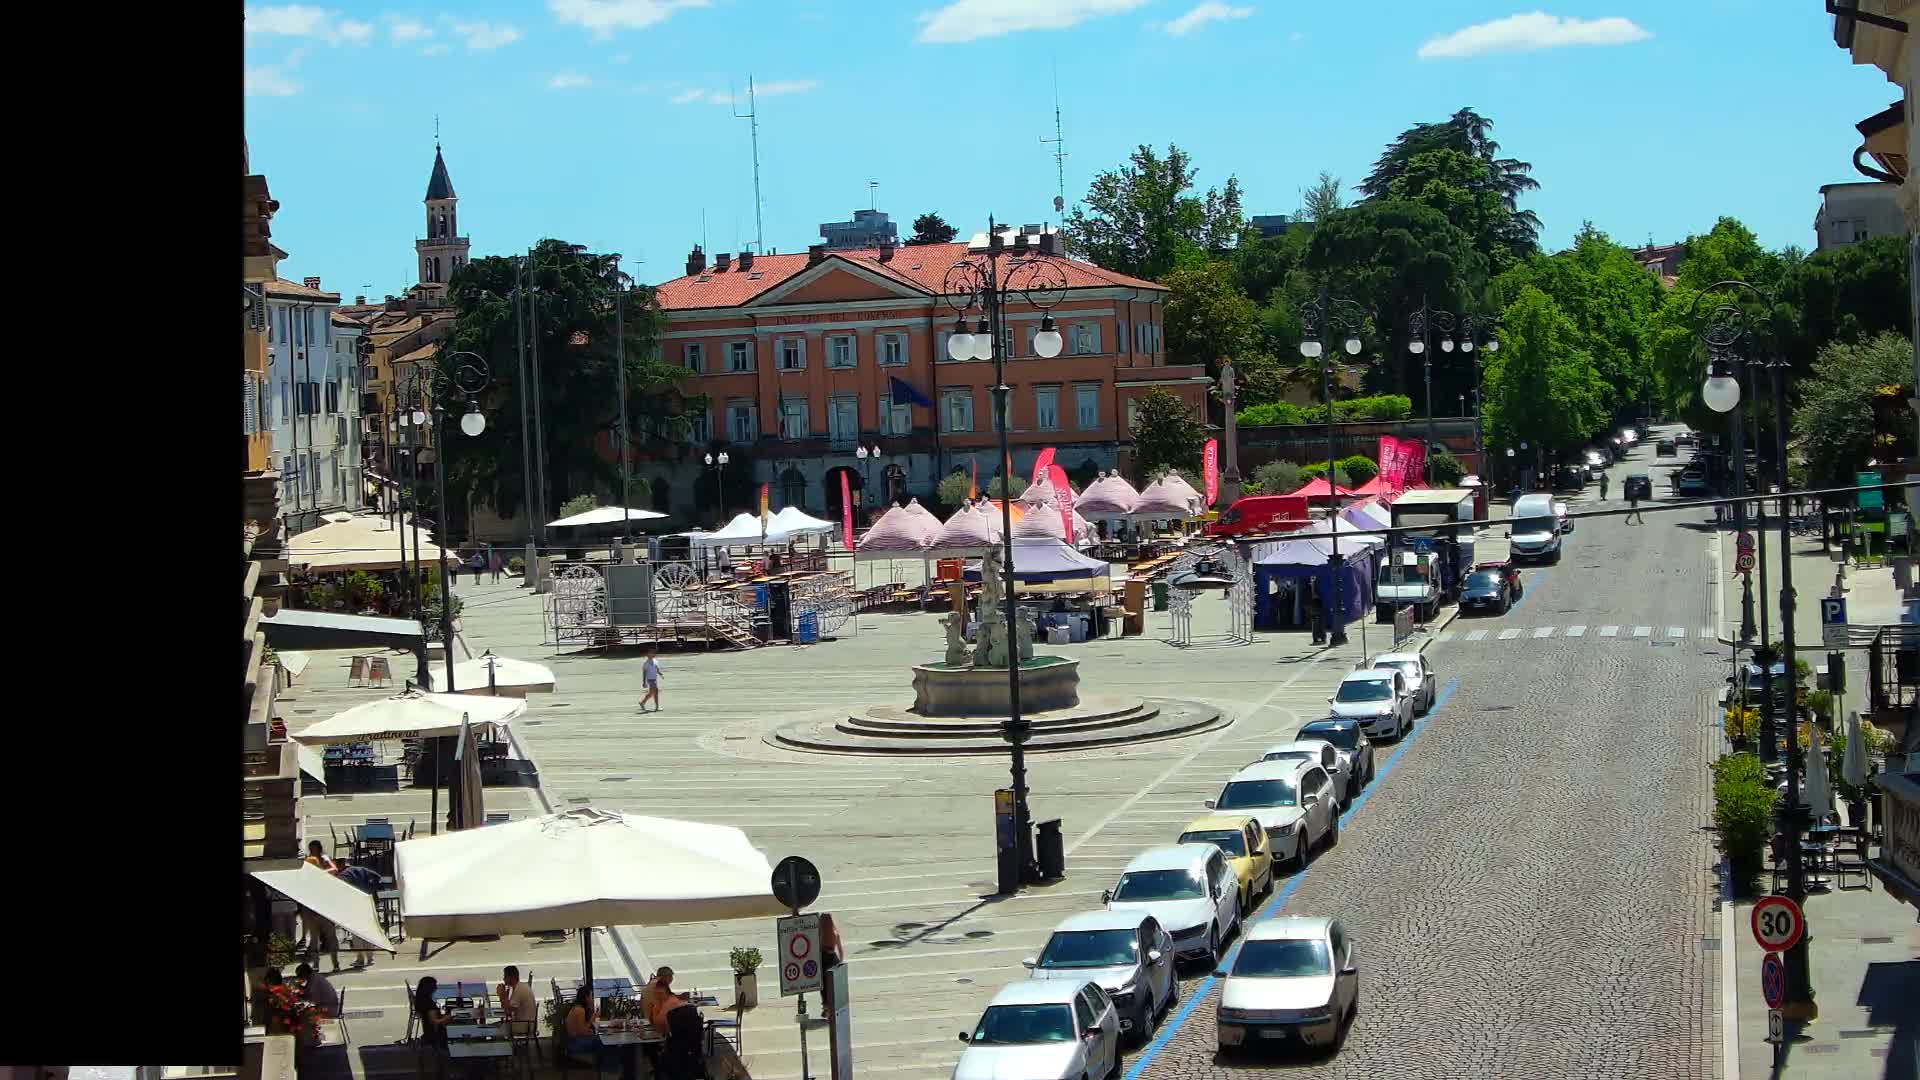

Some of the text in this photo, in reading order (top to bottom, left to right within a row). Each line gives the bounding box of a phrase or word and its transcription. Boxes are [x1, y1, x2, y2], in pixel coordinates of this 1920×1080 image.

[1741, 556, 1752, 566] 20
[1825, 601, 1840, 621] P
[1761, 911, 1790, 937] 30
